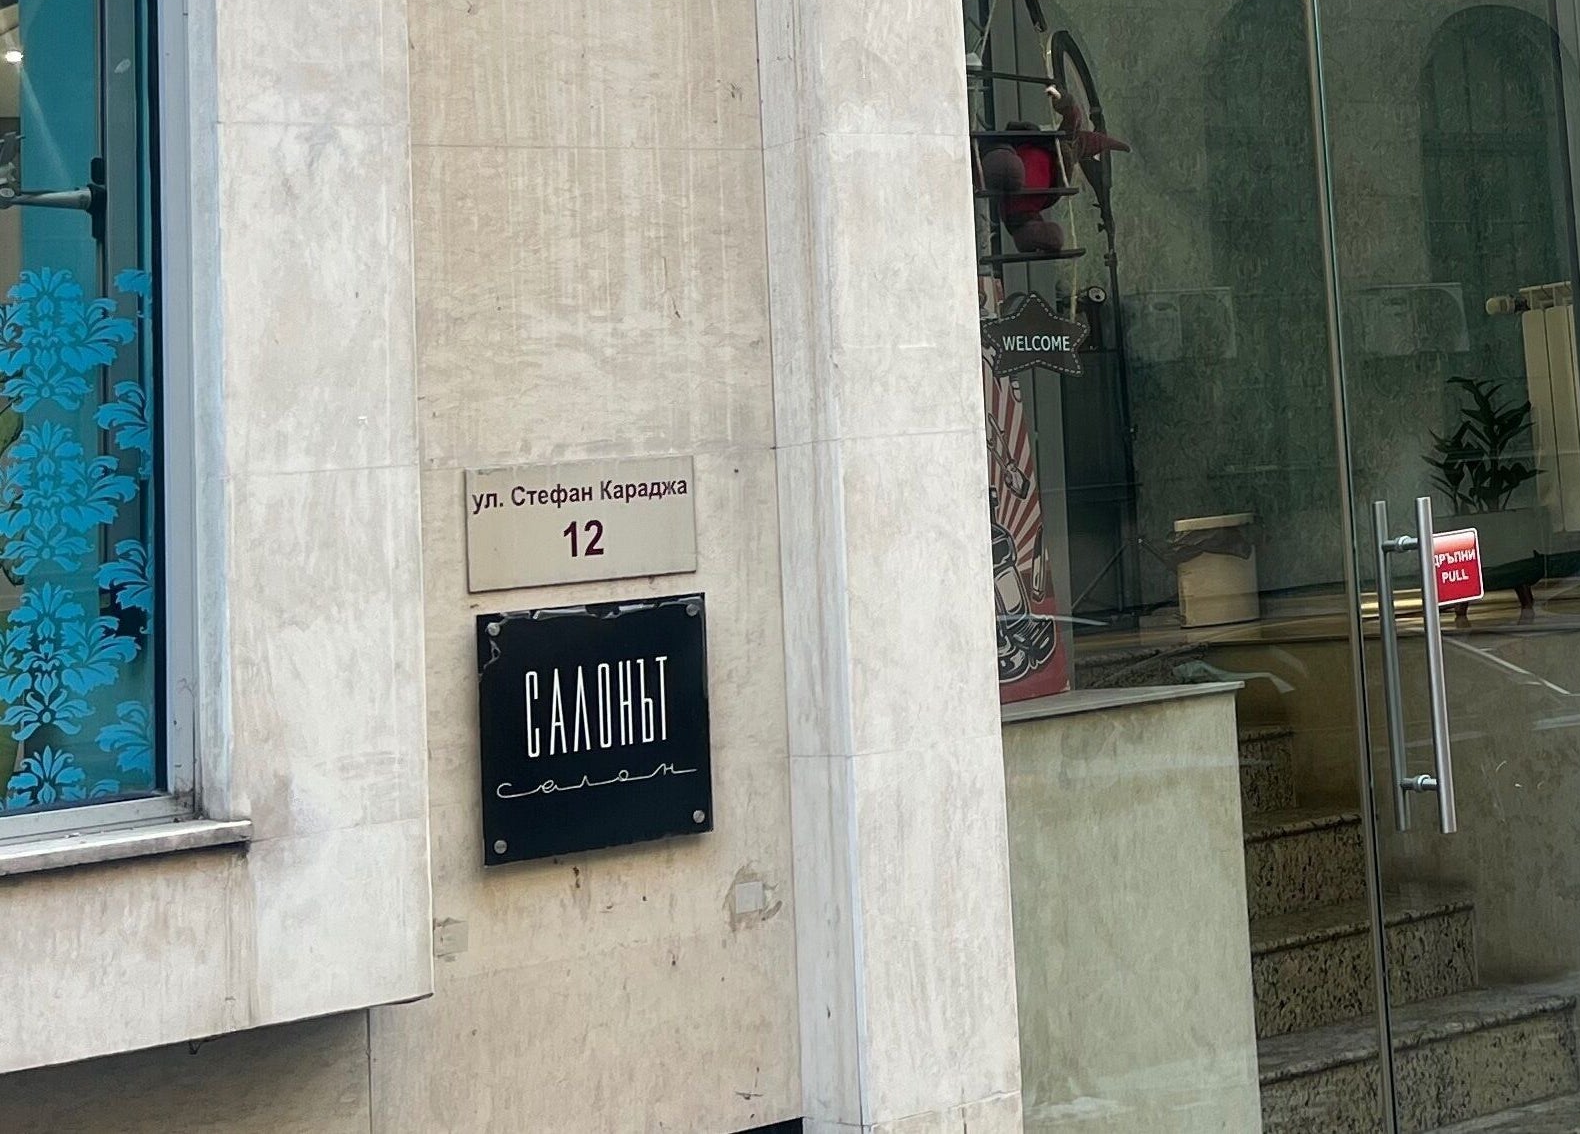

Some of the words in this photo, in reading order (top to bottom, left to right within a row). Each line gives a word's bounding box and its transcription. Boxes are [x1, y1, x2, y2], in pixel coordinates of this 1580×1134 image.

[1002, 335, 1071, 351] WELCOME
[472, 491, 504, 514] ул.
[511, 484, 593, 508] Стефан
[600, 480, 687, 503] Караджа
[563, 519, 605, 557] 12
[1441, 568, 1470, 584] PULL
[525, 655, 668, 758] САЛОНЪТ
[496, 763, 698, 799] салон
